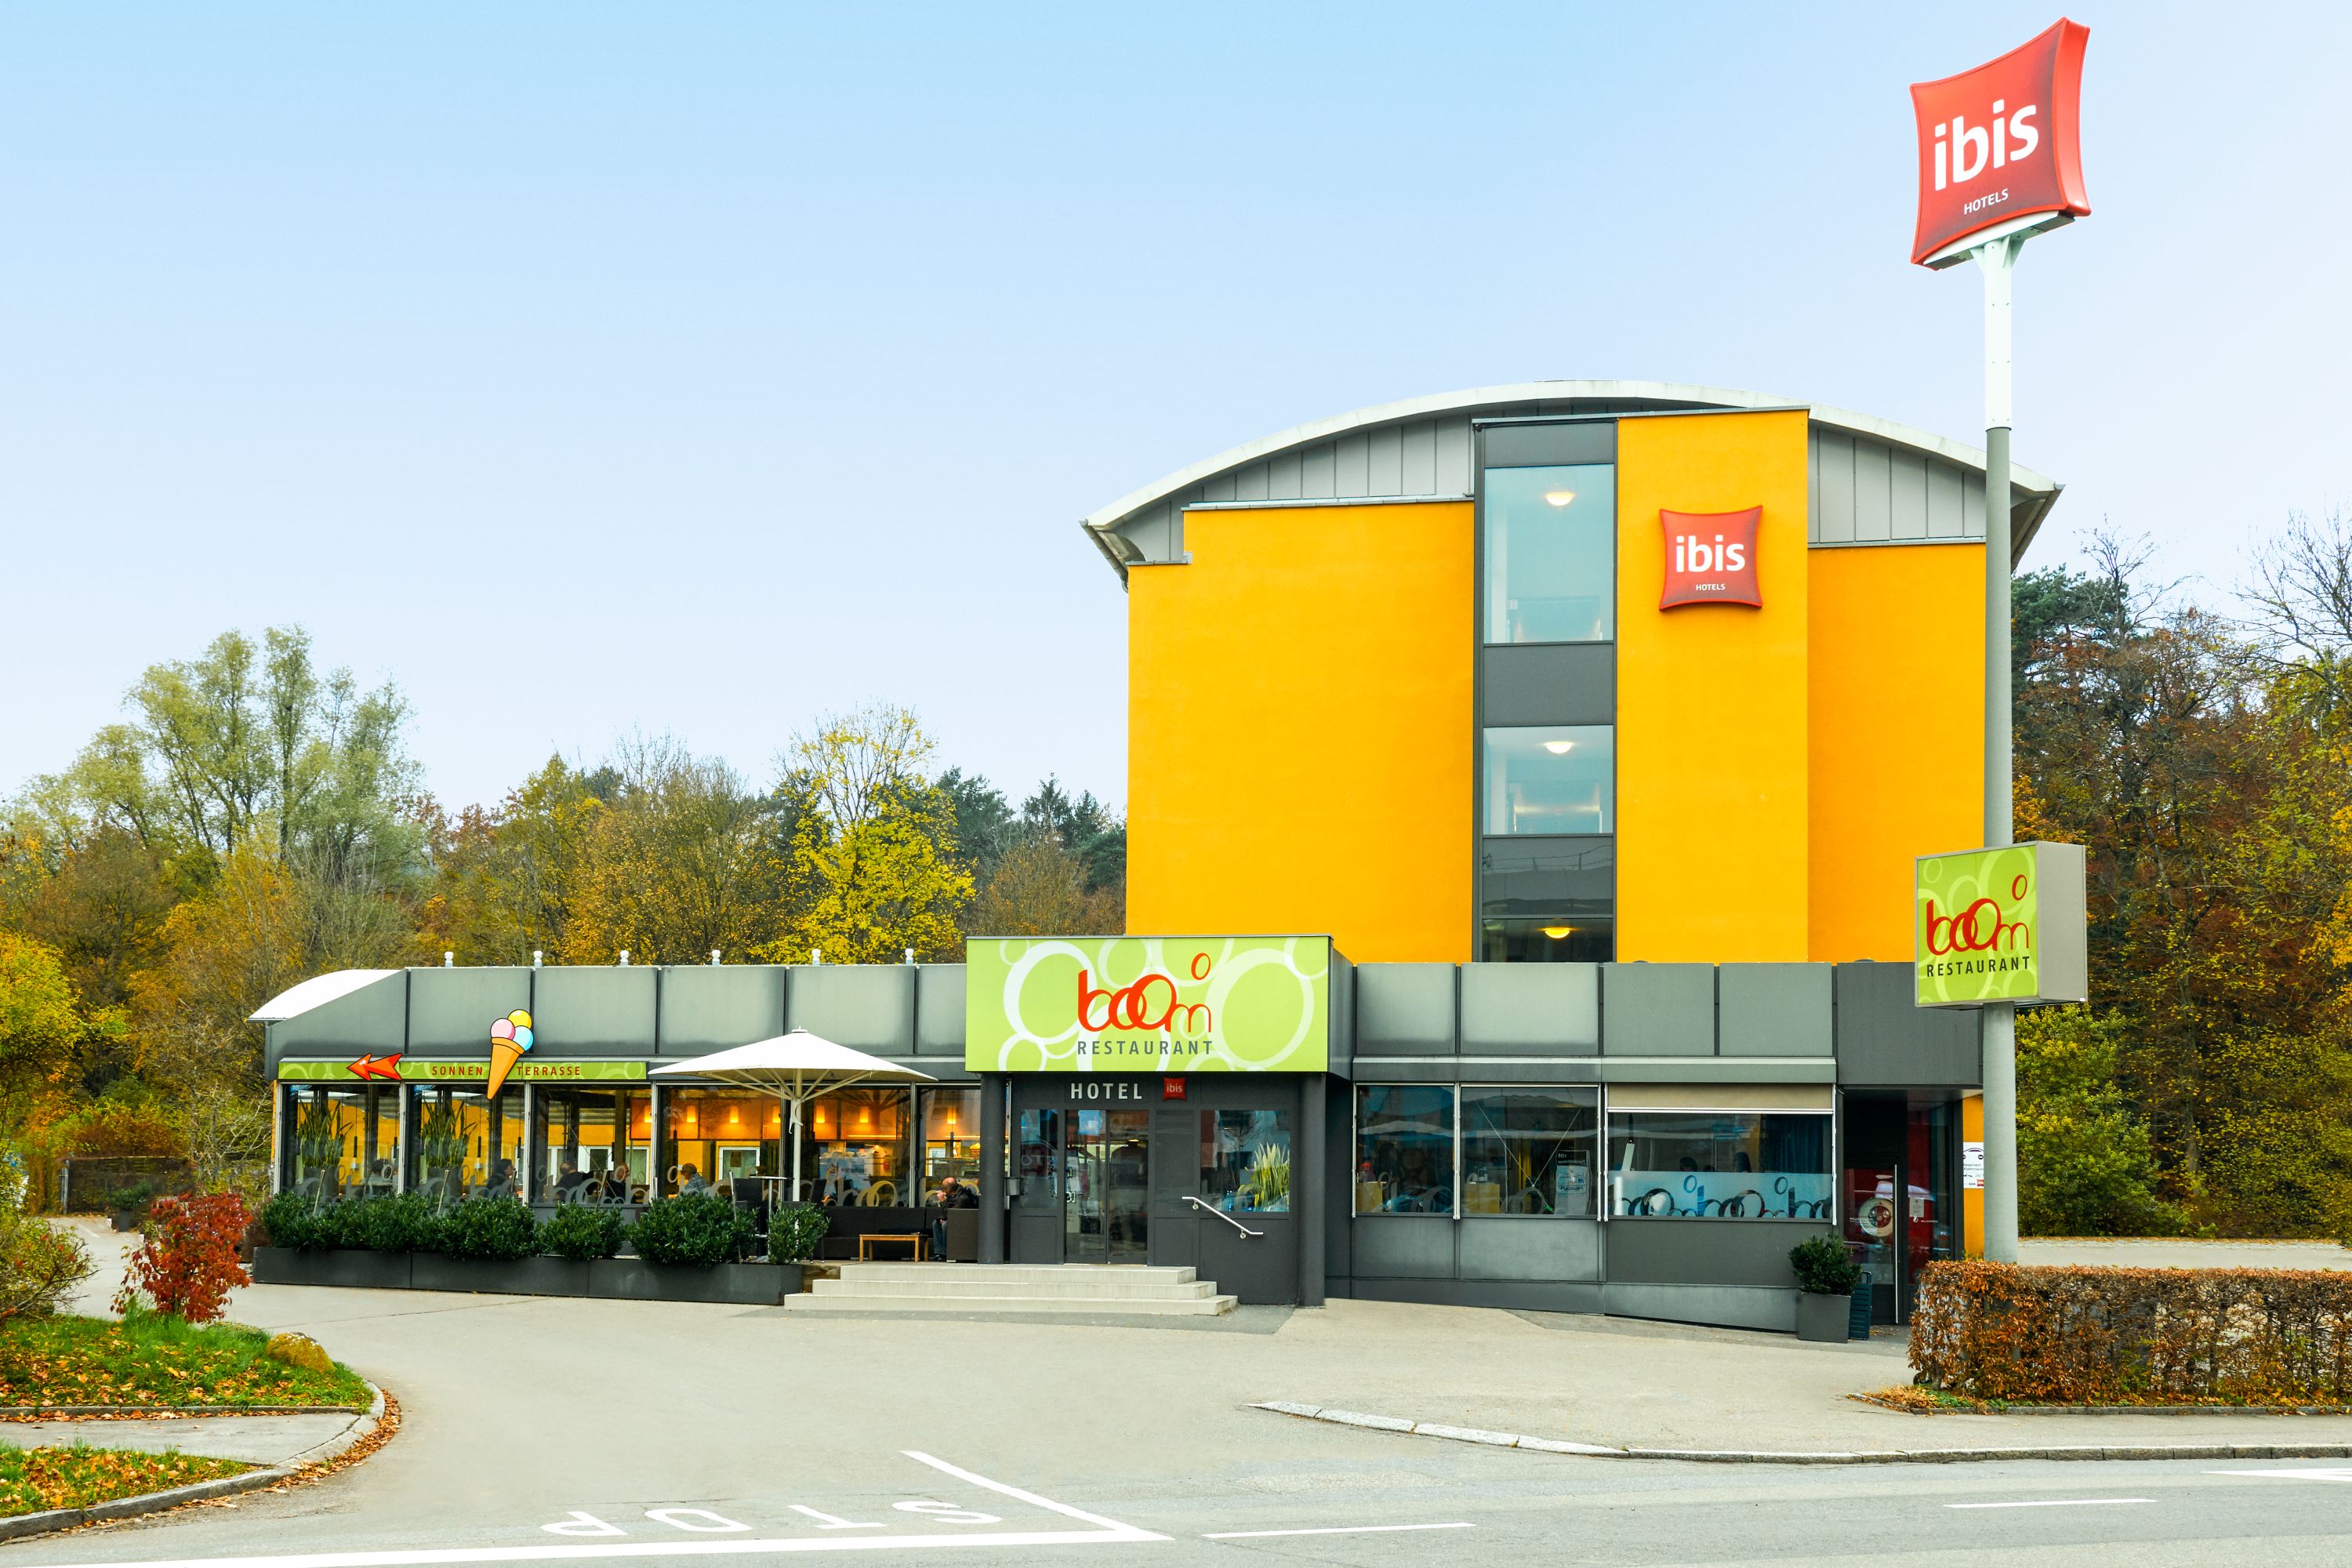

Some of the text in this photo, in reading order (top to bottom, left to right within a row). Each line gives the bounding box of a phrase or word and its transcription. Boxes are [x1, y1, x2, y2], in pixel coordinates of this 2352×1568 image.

[1935, 99, 2038, 191] ibis
[1963, 188, 2009, 215] HOTELS
[1675, 535, 1745, 572] ibis
[1927, 956, 2030, 977] RESTAURANT
[1077, 1040, 1213, 1055] RESTAURANT
[432, 1066, 580, 1076] SONNEN TERRASSE
[1070, 1083, 1142, 1099] HOTEL
[1167, 1083, 1183, 1093] ibis
[540, 1500, 1003, 1537] STOP
